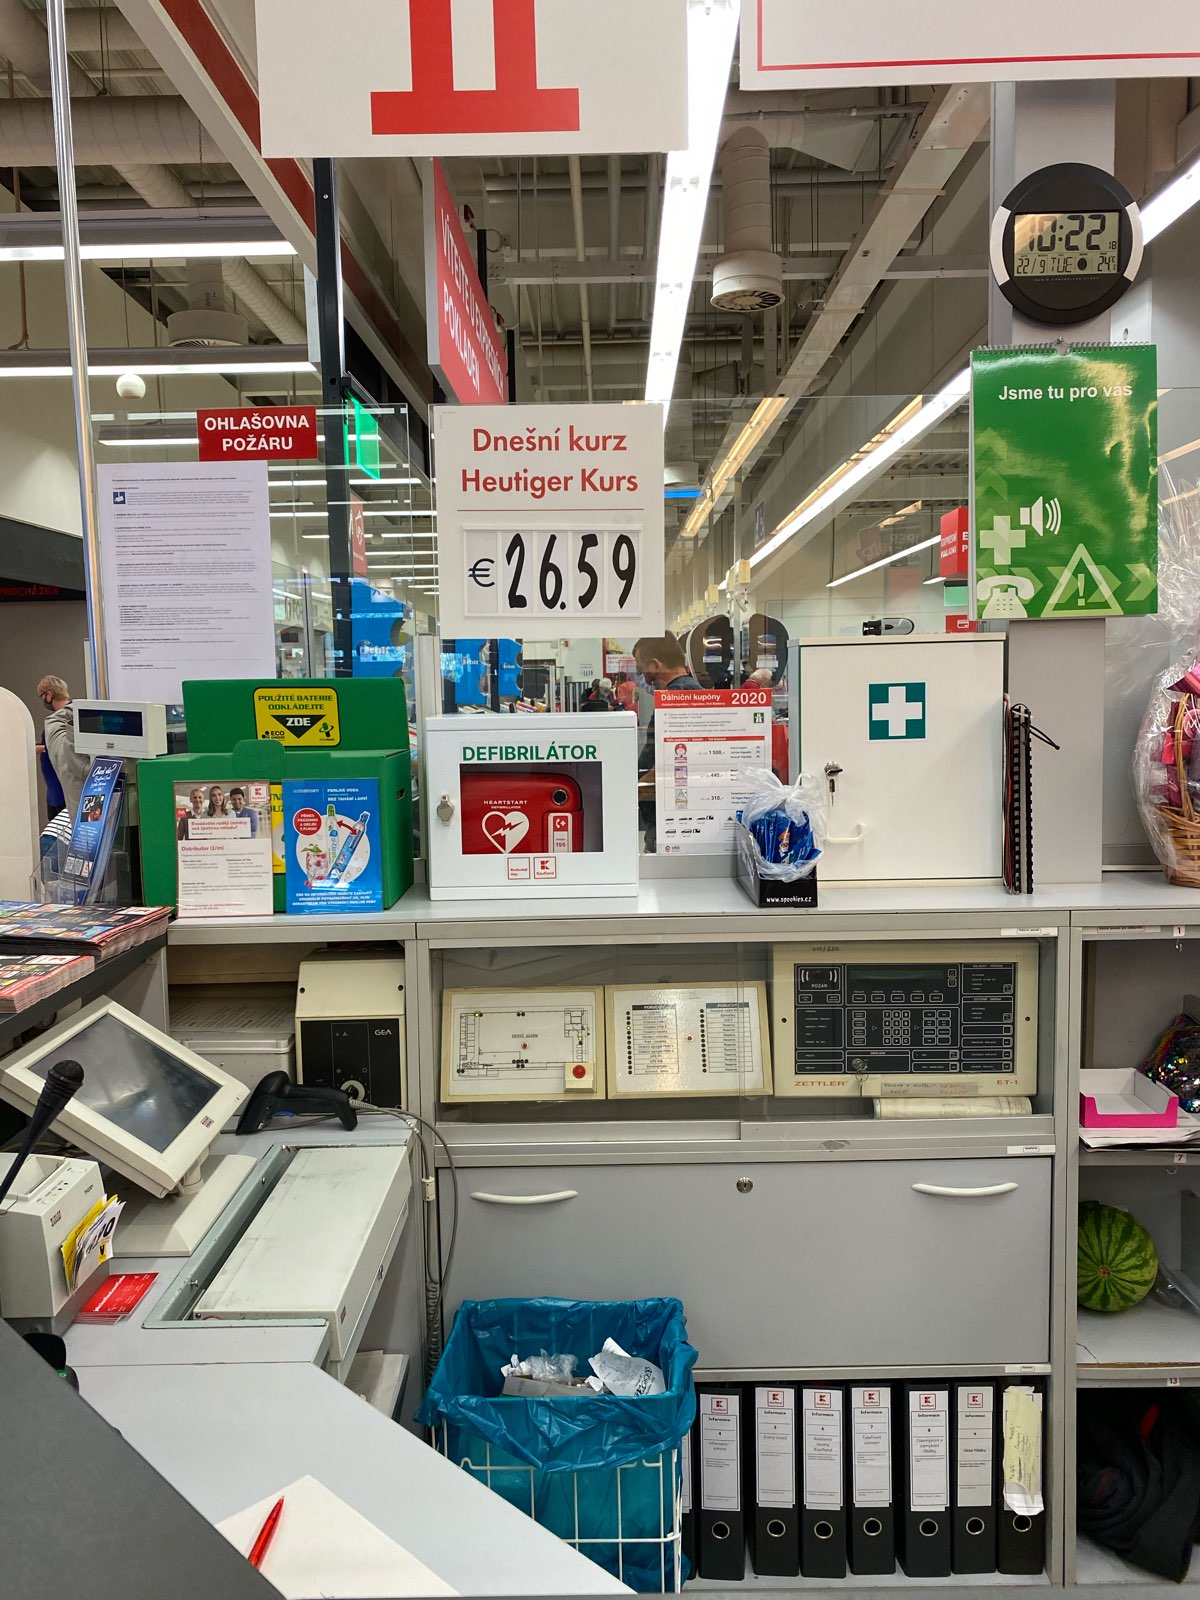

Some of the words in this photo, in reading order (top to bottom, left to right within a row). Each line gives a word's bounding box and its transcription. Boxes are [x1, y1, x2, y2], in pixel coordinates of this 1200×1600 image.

[1028, 214, 1106, 252] 10:22
[1108, 241, 1116, 250] 18
[1051, 257, 1073, 273] TUE
[998, 386, 1042, 400] Jsme
[1048, 385, 1064, 400] tu
[1069, 387, 1098, 402] pro
[1103, 383, 1133, 398] vás
[204, 413, 310, 430] OHLAŠOVNA
[222, 434, 293, 452] POŽÁRU
[473, 427, 560, 452] Dnešní
[569, 425, 627, 452] kurz
[462, 468, 574, 498] Heutiger
[581, 468, 638, 492] Kurs
[505, 533, 636, 610] 26.59
[732, 692, 766, 704] 2020
[286, 718, 312, 726] ZDE
[462, 741, 598, 761] DEFIBRILÁTOR
